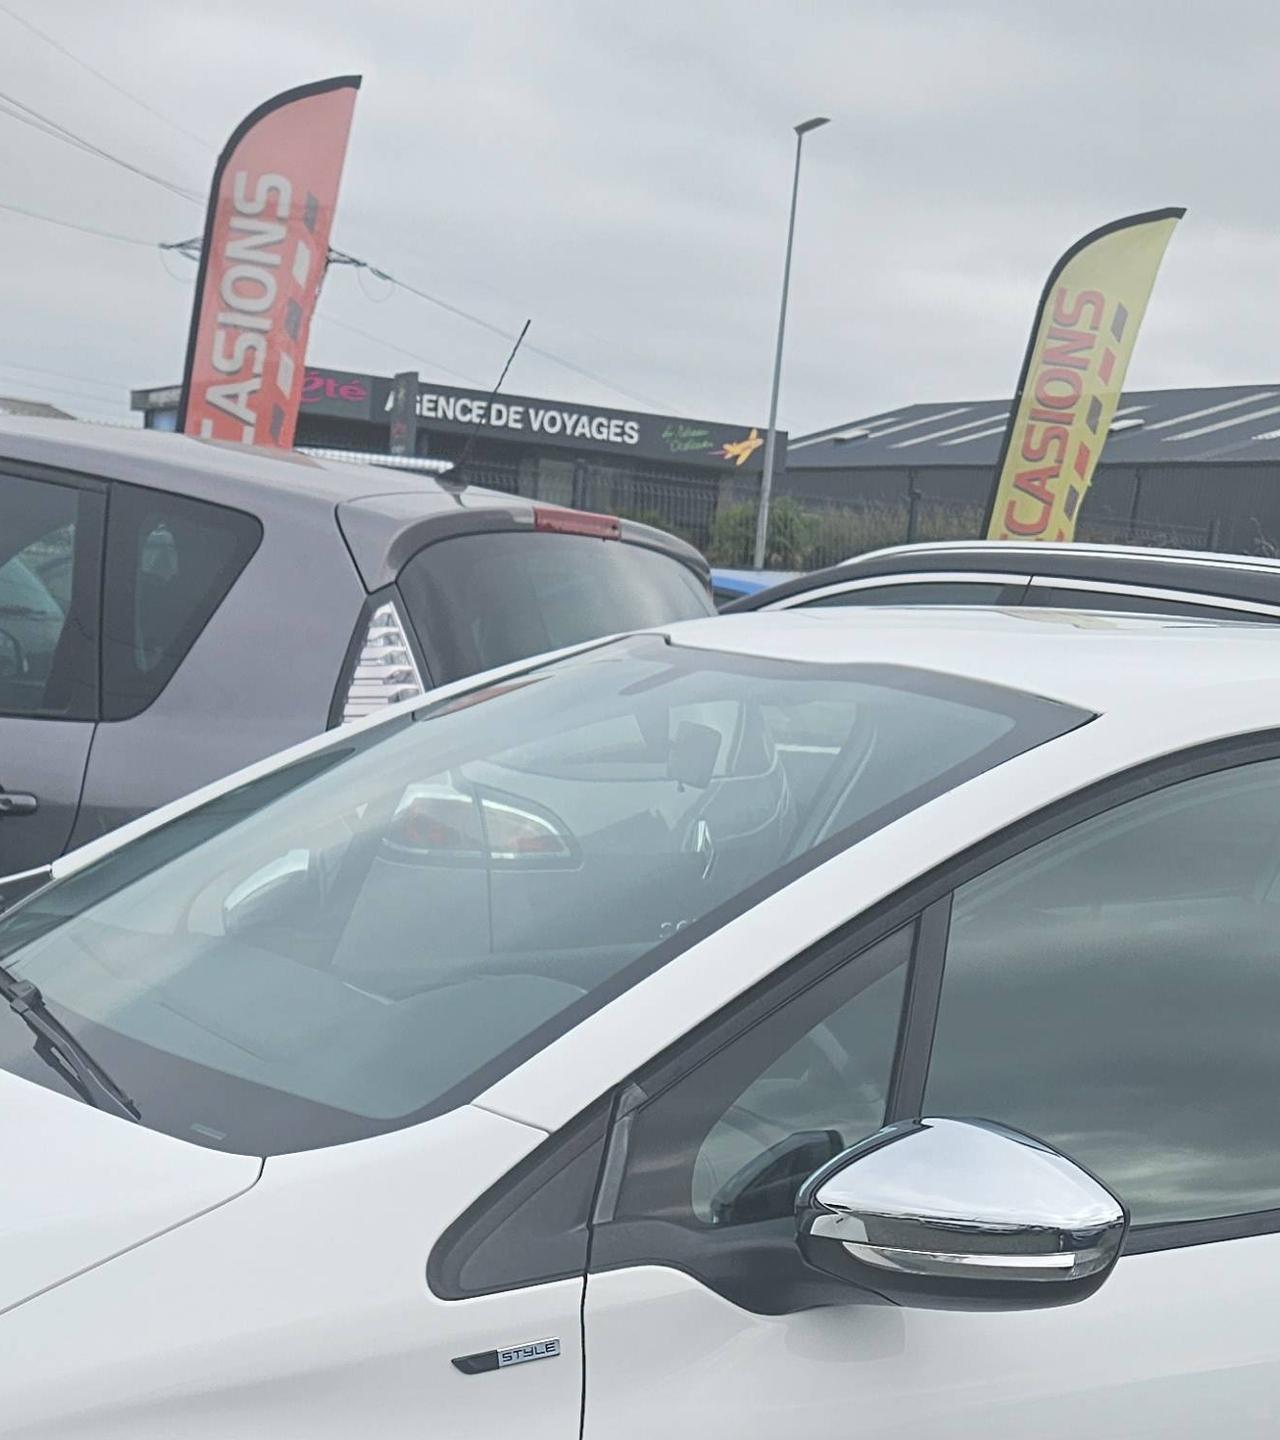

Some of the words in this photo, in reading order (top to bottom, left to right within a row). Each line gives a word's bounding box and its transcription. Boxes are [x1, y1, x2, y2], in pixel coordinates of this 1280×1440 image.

[489, 403, 523, 429] DE
[528, 408, 640, 445] VOYAGES
[1000, 287, 1106, 541] CASIONS
[502, 1342, 557, 1363] STYLE
